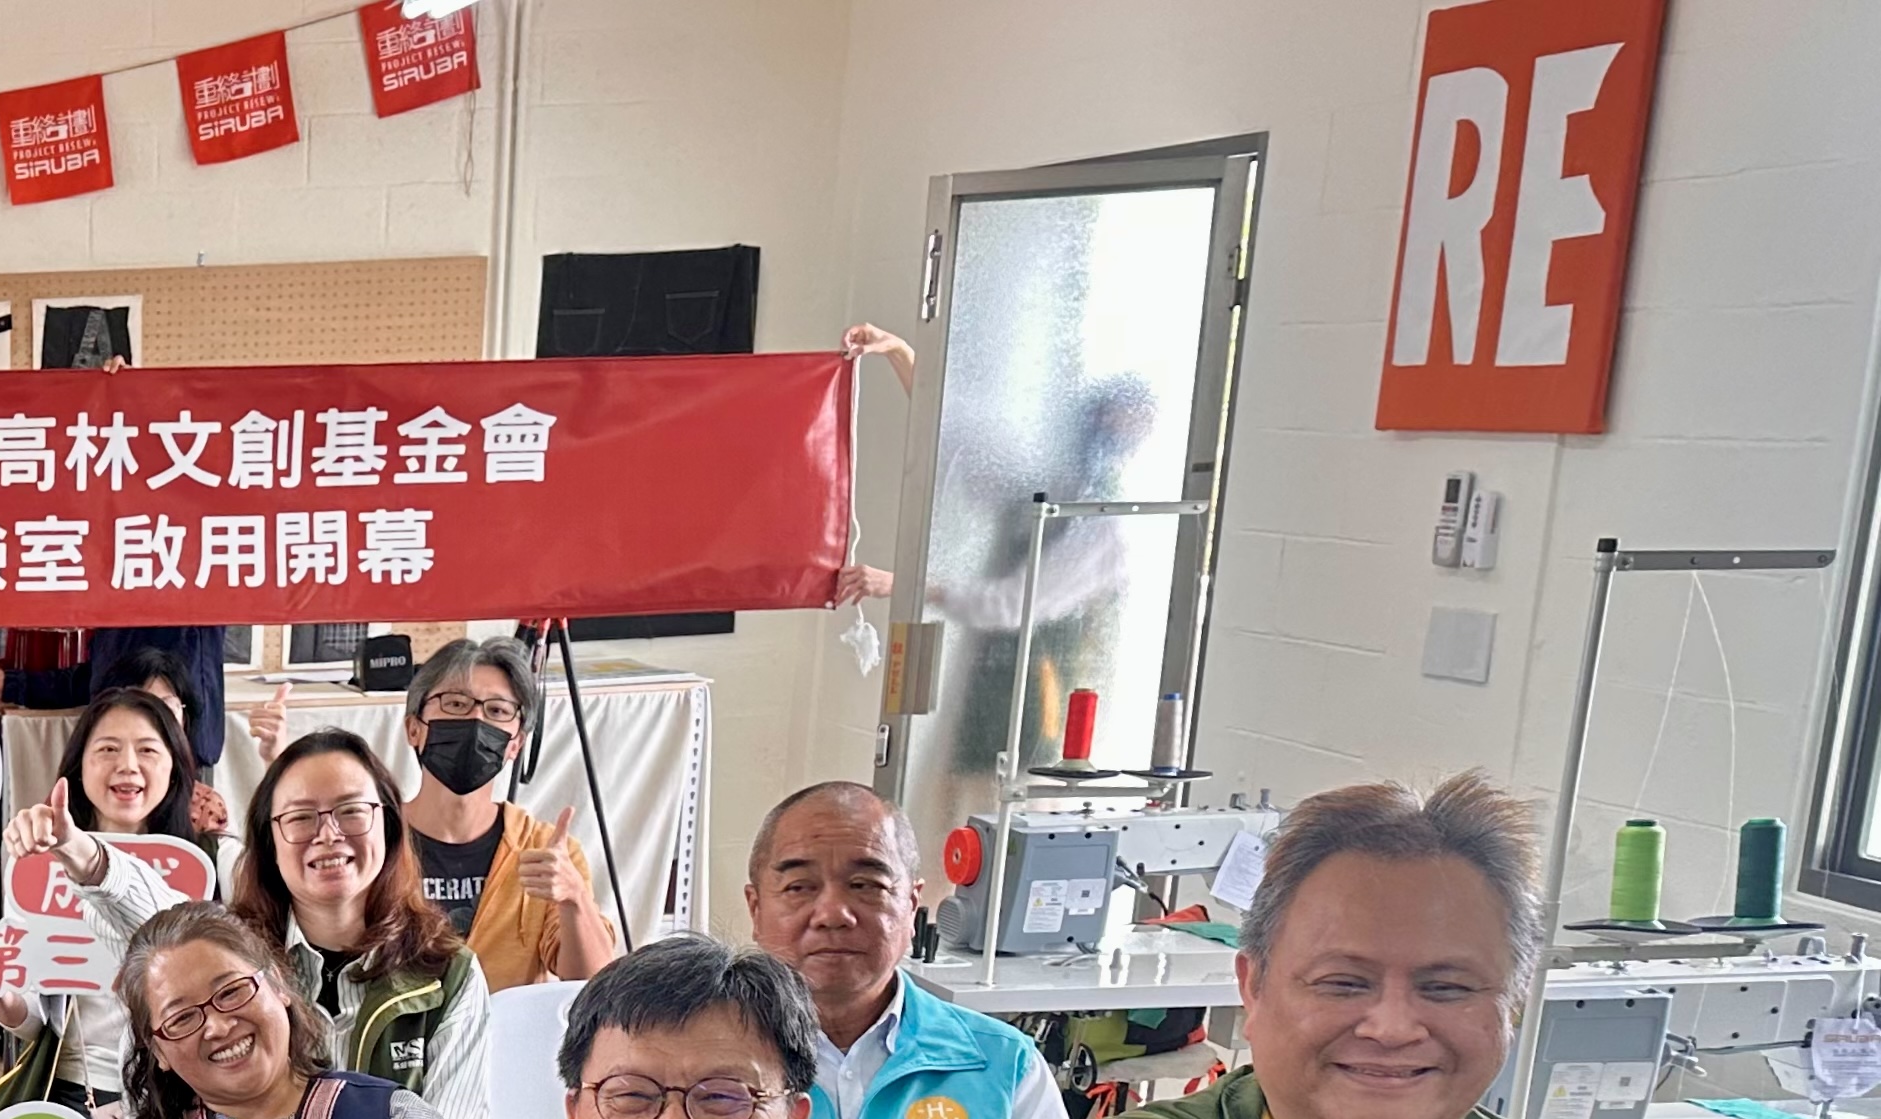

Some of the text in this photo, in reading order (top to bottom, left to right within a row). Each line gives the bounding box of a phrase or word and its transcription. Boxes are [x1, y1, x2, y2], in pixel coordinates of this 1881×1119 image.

[381, 51, 423, 72] PROJECT
[197, 102, 240, 121] PROJECT
[13, 146, 55, 160] PROJECT
[1392, 42, 1625, 367] RE
[111, 508, 434, 590] 啟用開幕
[370, 656, 406, 669] MIPRO
